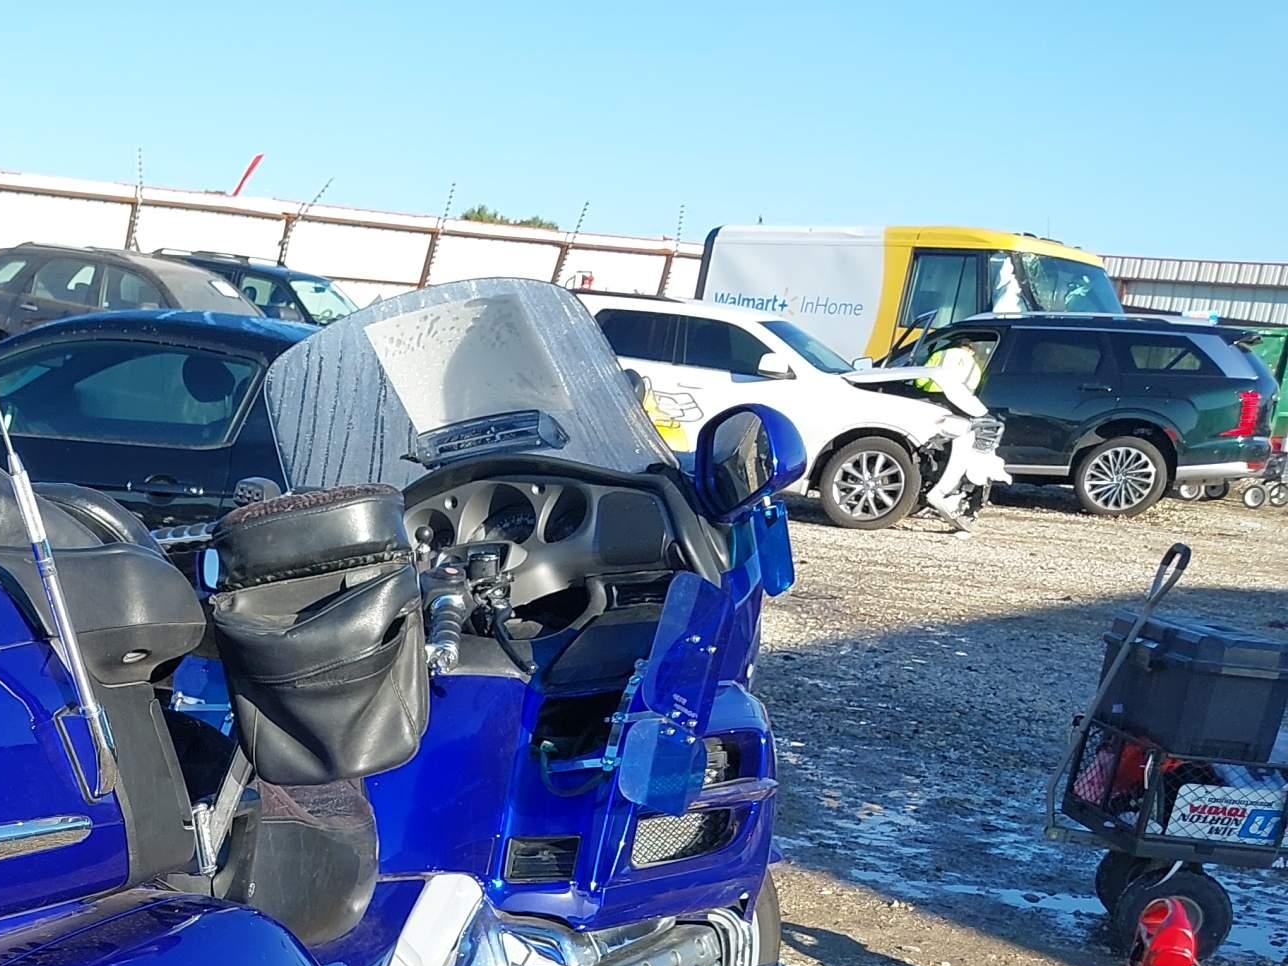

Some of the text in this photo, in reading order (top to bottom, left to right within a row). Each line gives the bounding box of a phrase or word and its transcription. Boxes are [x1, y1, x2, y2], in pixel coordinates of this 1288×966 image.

[714, 292, 864, 316] Walmart+ InHome
[1189, 804, 1247, 818] TOYOTA
[1179, 813, 1243, 826] NORTON
[1208, 826, 1237, 836] JIM
